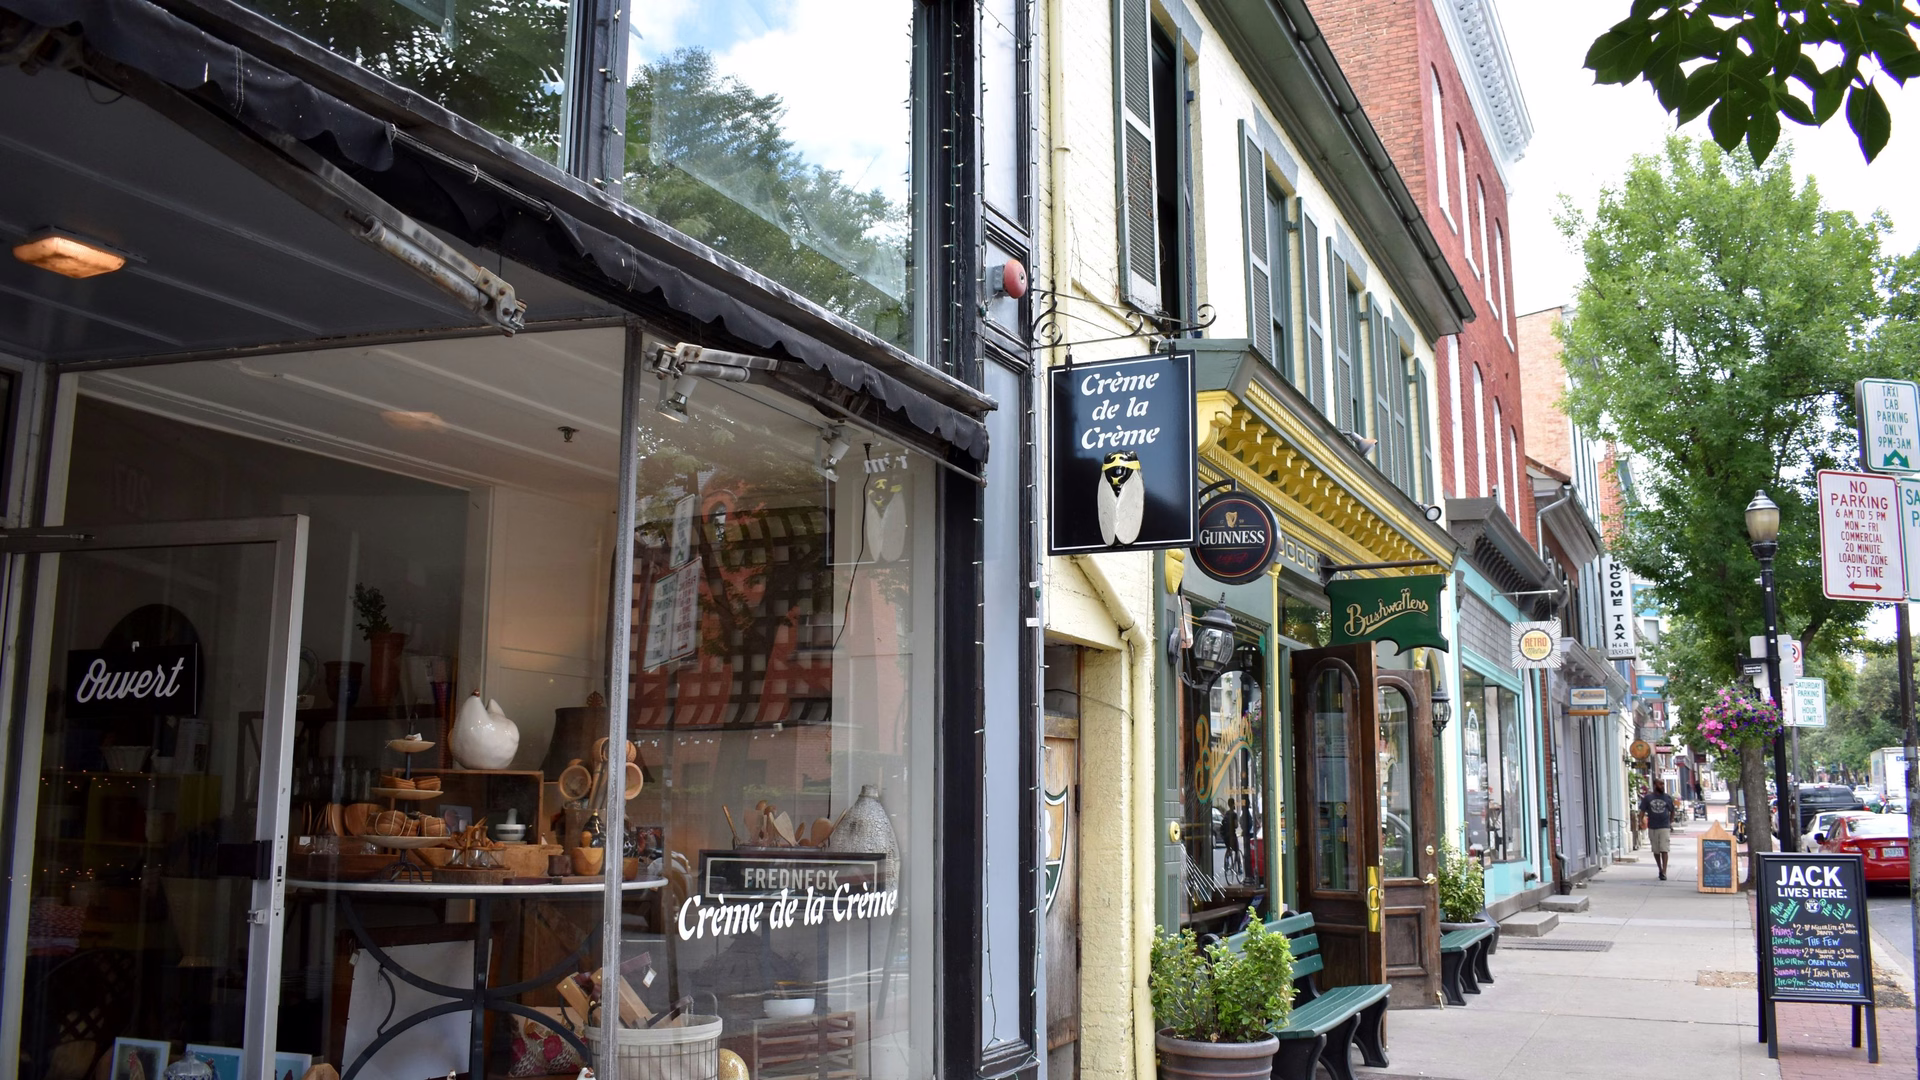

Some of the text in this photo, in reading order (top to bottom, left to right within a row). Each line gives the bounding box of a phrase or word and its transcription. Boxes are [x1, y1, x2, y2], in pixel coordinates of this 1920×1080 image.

[1081, 371, 1160, 396] Crème
[1882, 385, 1899, 398] TAXI
[1092, 396, 1149, 421] de la
[1884, 398, 1899, 410] CAB
[1877, 410, 1909, 424] PARKING
[1884, 423, 1903, 436] ONLY
[1081, 425, 1160, 450] Crème
[1878, 436, 1912, 450] 9PM-3AM
[1849, 480, 1867, 494] NO
[1830, 493, 1889, 510] PARKING
[1835, 508, 1887, 521] 6 AM TO 5 PM
[1844, 520, 1859, 531] MON
[1868, 522, 1879, 532] FRI
[1200, 529, 1265, 546] GUINNESS
[1840, 531, 1884, 544] COMMERCIAL
[1845, 542, 1881, 554] 20 MINUTE
[1838, 553, 1889, 566] LOADING ZONE
[1846, 565, 1884, 579] $75 FINE
[1344, 587, 1429, 637] Bushwallers
[1612, 614, 1626, 640] TAX
[1524, 637, 1547, 647] RETRO
[77, 657, 184, 703] Ouvert
[1795, 681, 1820, 689] SATURDAY
[1797, 690, 1820, 698] PARKING
[1803, 698, 1814, 706] ONE
[1802, 706, 1817, 714] HOUR
[744, 867, 839, 891] FREDNECK
[1775, 865, 1843, 887] JACK
[1777, 887, 1809, 898] LIVES
[678, 882, 898, 941] Crème de la Crème
